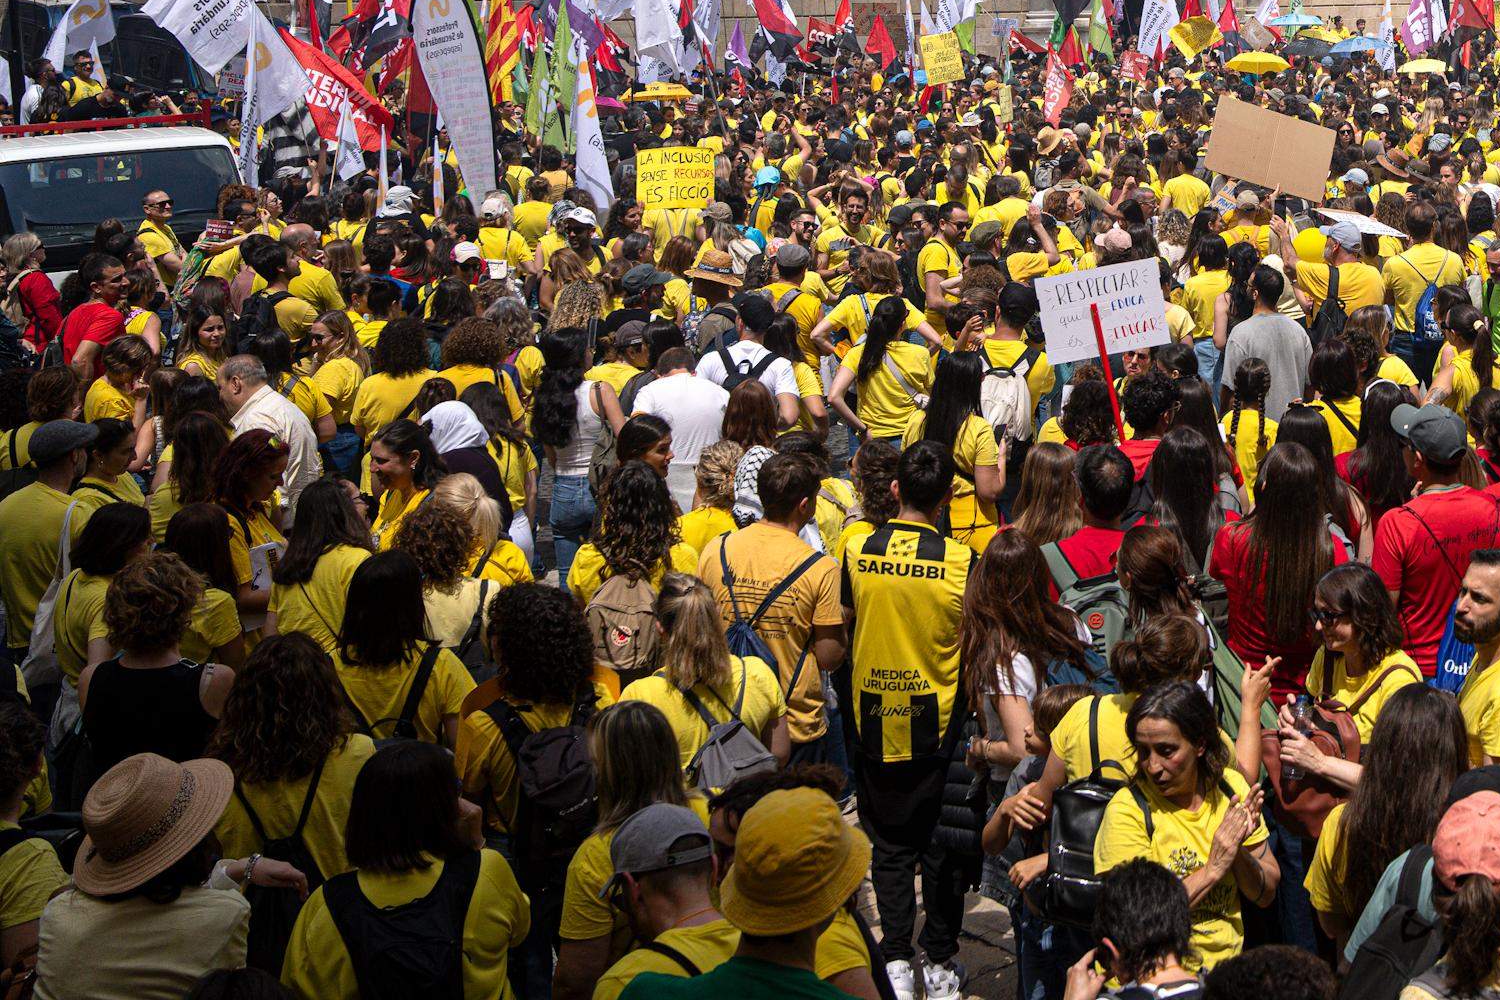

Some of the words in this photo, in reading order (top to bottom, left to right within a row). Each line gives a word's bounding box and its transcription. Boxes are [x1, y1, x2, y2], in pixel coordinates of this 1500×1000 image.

[640, 153, 654, 166] LA
[661, 149, 711, 165] INCLUSIÓ
[640, 169, 668, 182] SENSE
[674, 166, 715, 180] RECURSOS
[646, 184, 663, 204] ÉS
[669, 181, 710, 201] FICCIÓ
[1055, 268, 1139, 306] RESPECTAR
[1111, 294, 1145, 312] EDUCA
[1113, 317, 1158, 340] EDUCAR
[857, 559, 946, 580] SARUBBI
[870, 667, 921, 681] MEDICA
[863, 677, 931, 692] URUGUAYA
[869, 702, 926, 717] NUÑEZ
